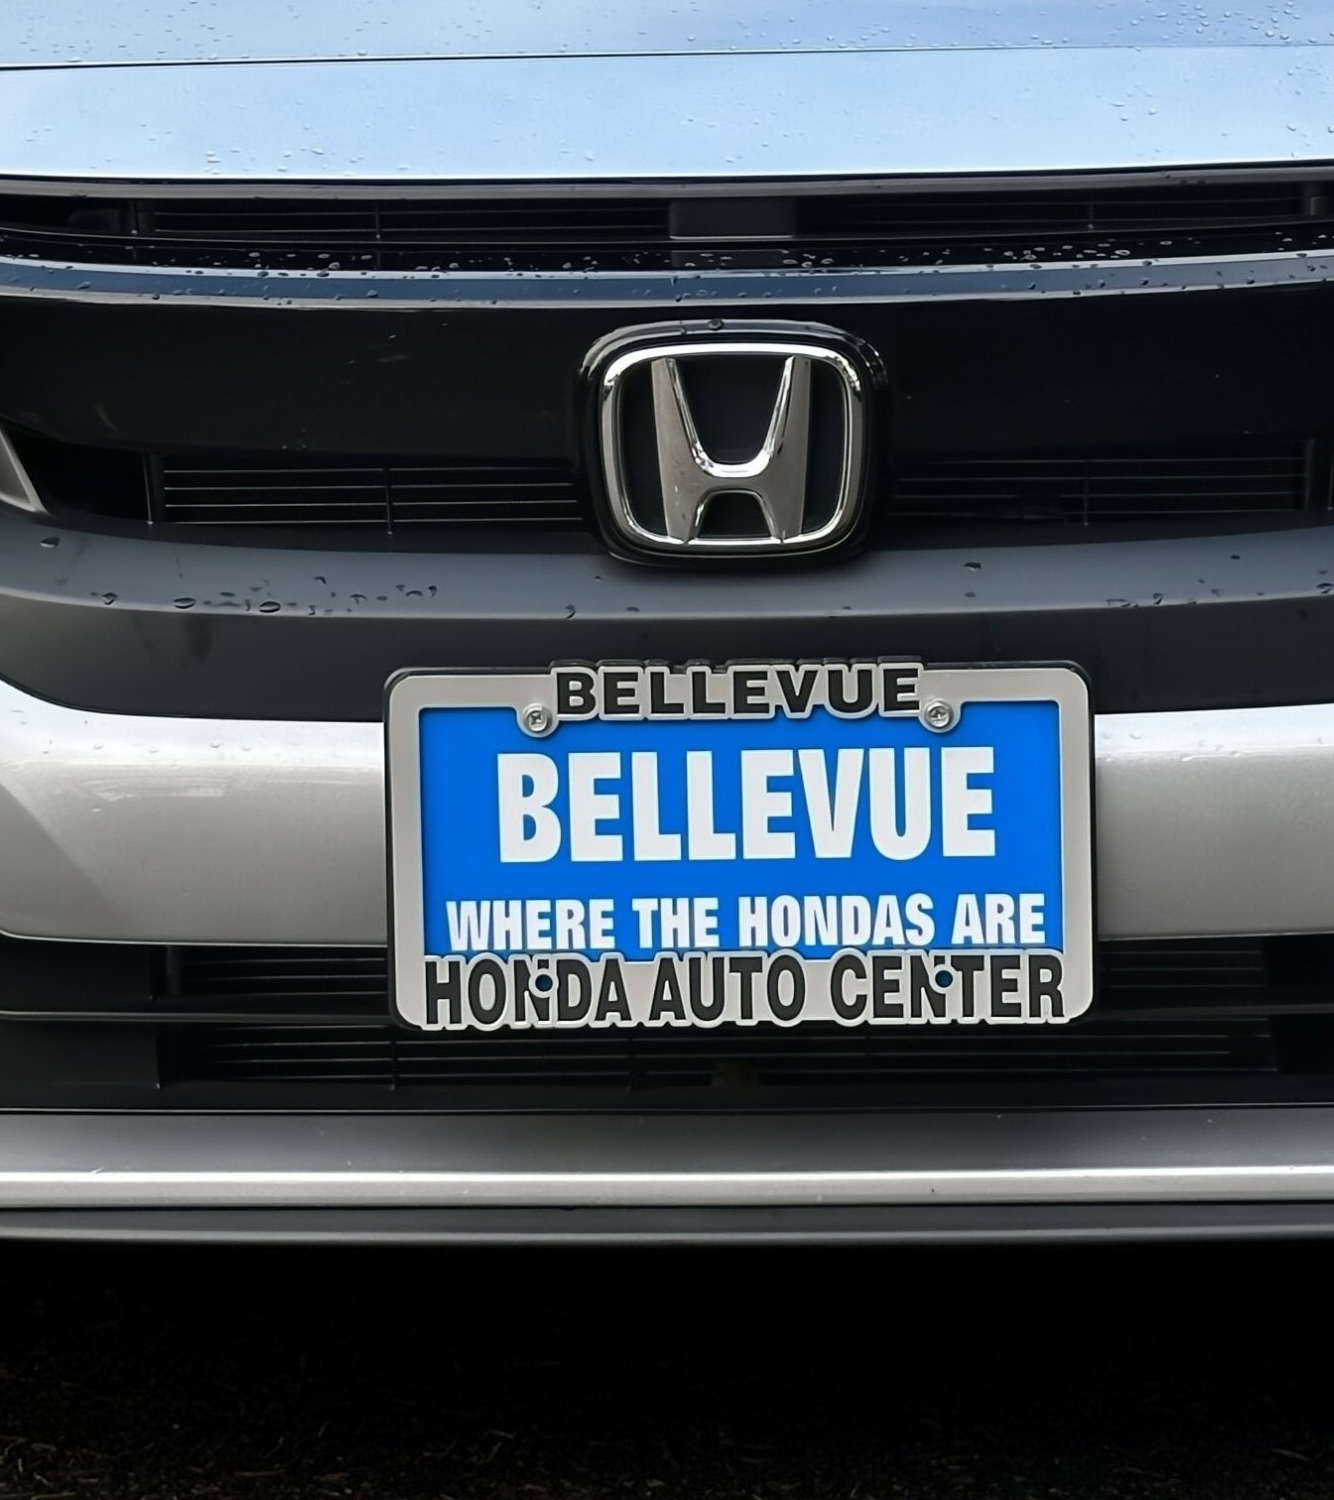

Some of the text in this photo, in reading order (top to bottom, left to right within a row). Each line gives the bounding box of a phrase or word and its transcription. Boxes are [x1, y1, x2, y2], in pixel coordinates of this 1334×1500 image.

[556, 668, 920, 715] BELLEVUE
[497, 746, 996, 863] BELLEVUE
[446, 892, 1046, 952] WHERE THE HONDAS ARE
[425, 953, 1064, 1026] HONDA AUTO CENTER
